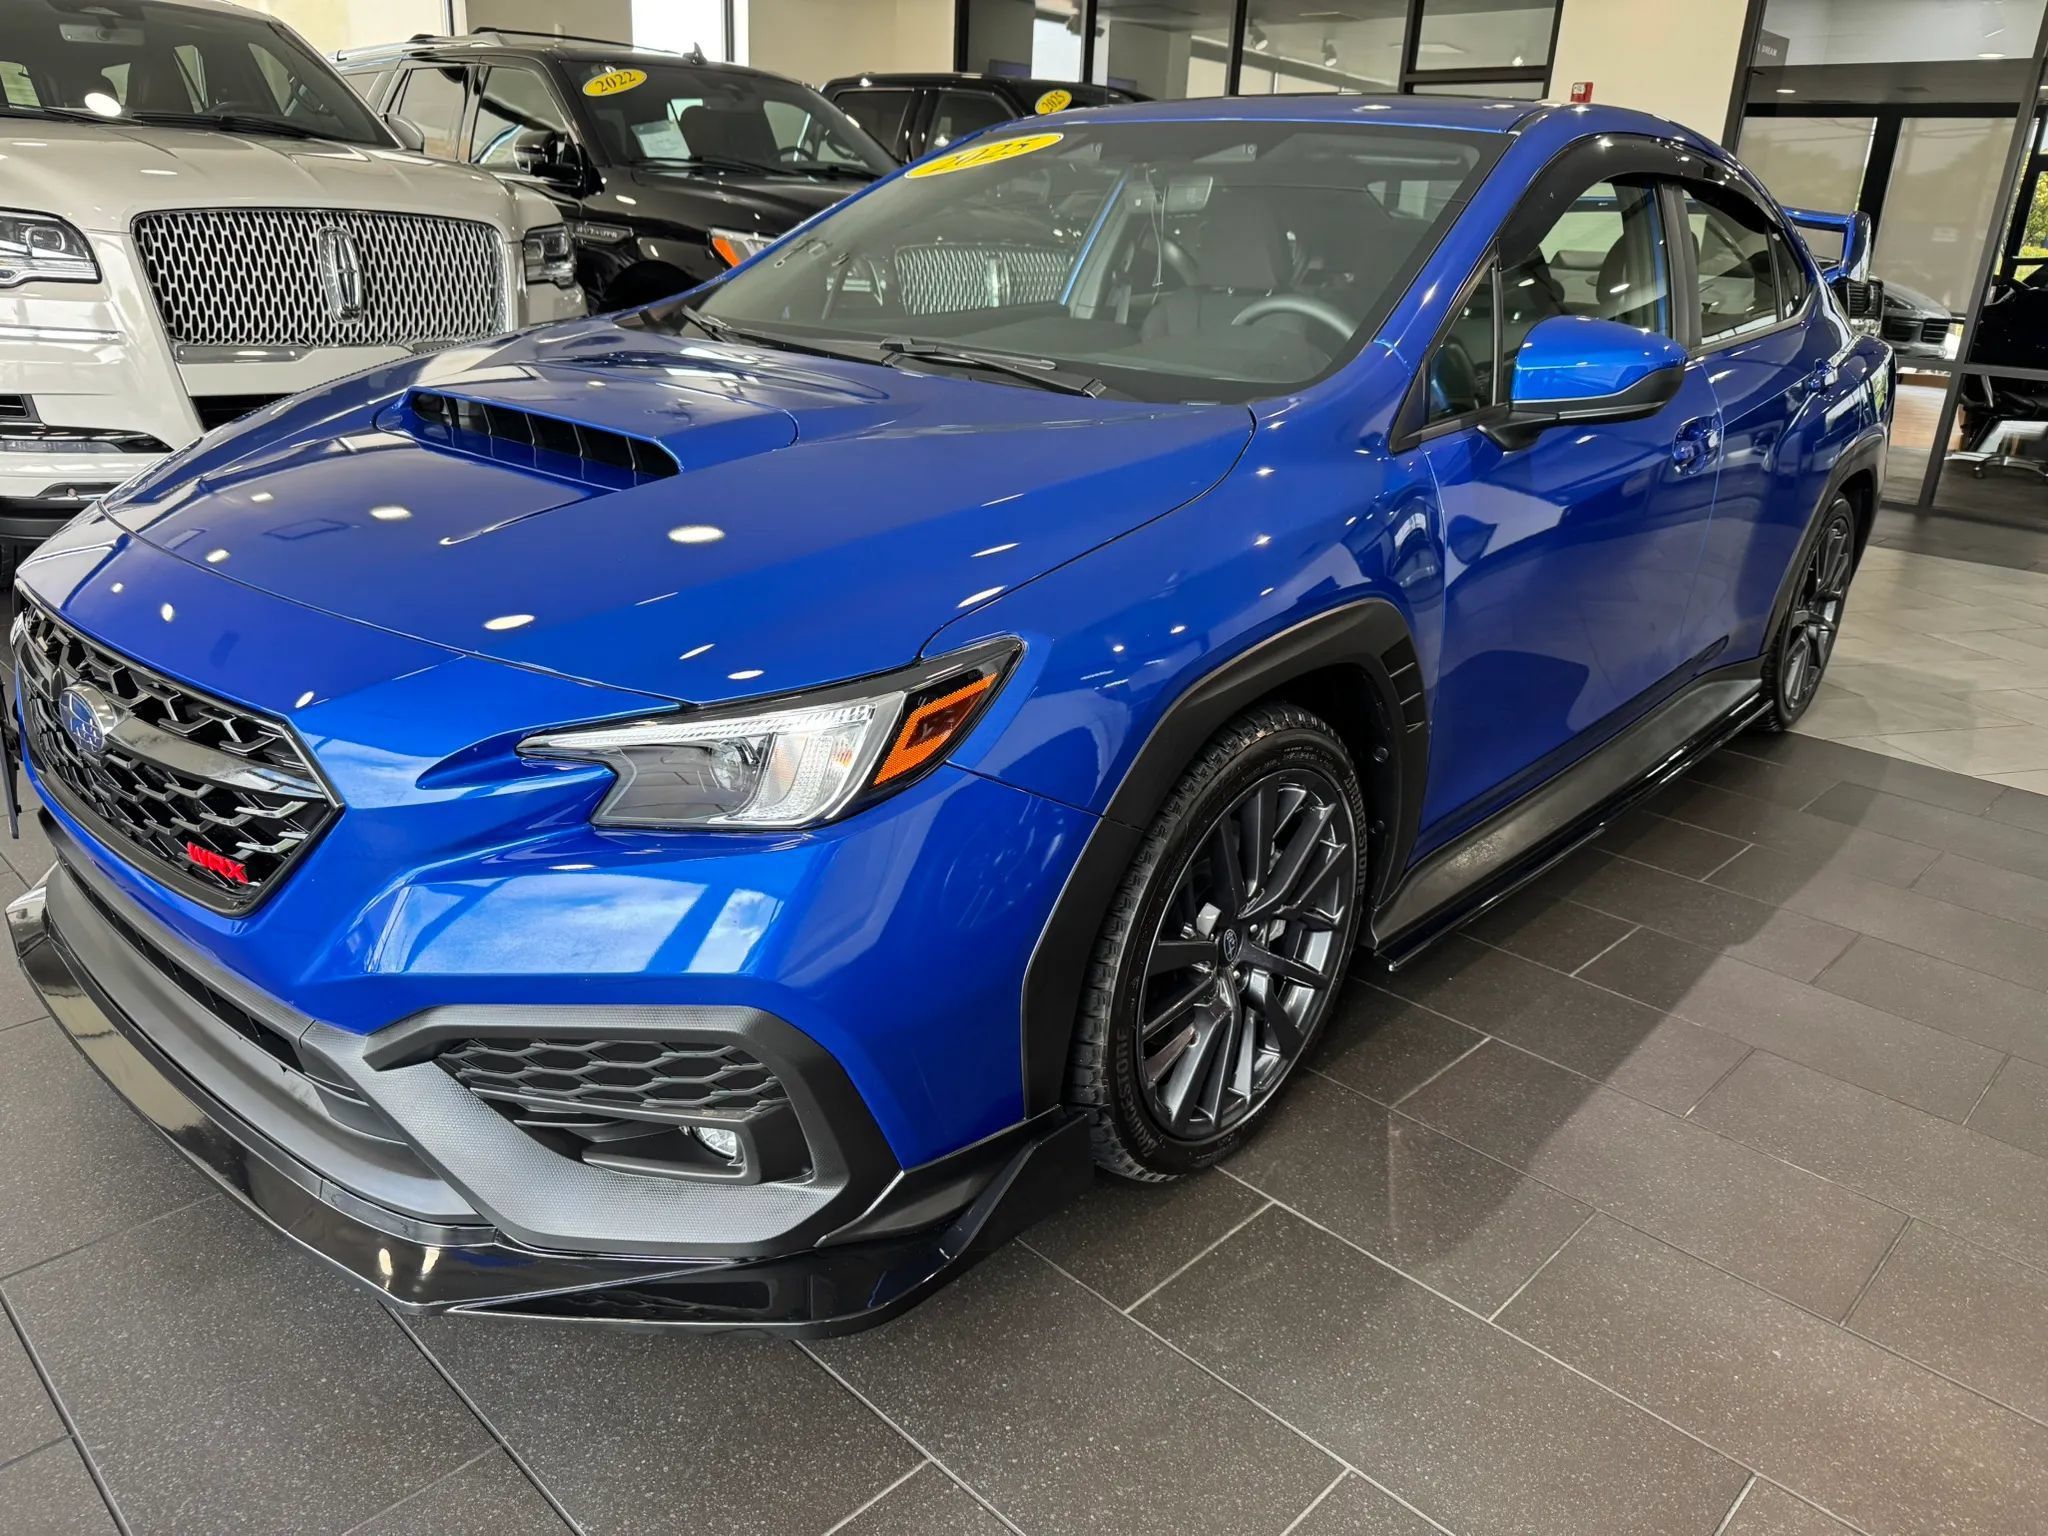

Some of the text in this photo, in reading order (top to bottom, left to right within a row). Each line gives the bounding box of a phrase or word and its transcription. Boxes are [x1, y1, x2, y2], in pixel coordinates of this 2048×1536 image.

[595, 71, 636, 93] 2022
[187, 841, 248, 884] WRX
[1343, 769, 1368, 895] BRIDGESTONE
[1116, 1028, 1159, 1158] BRIDGESTONE
